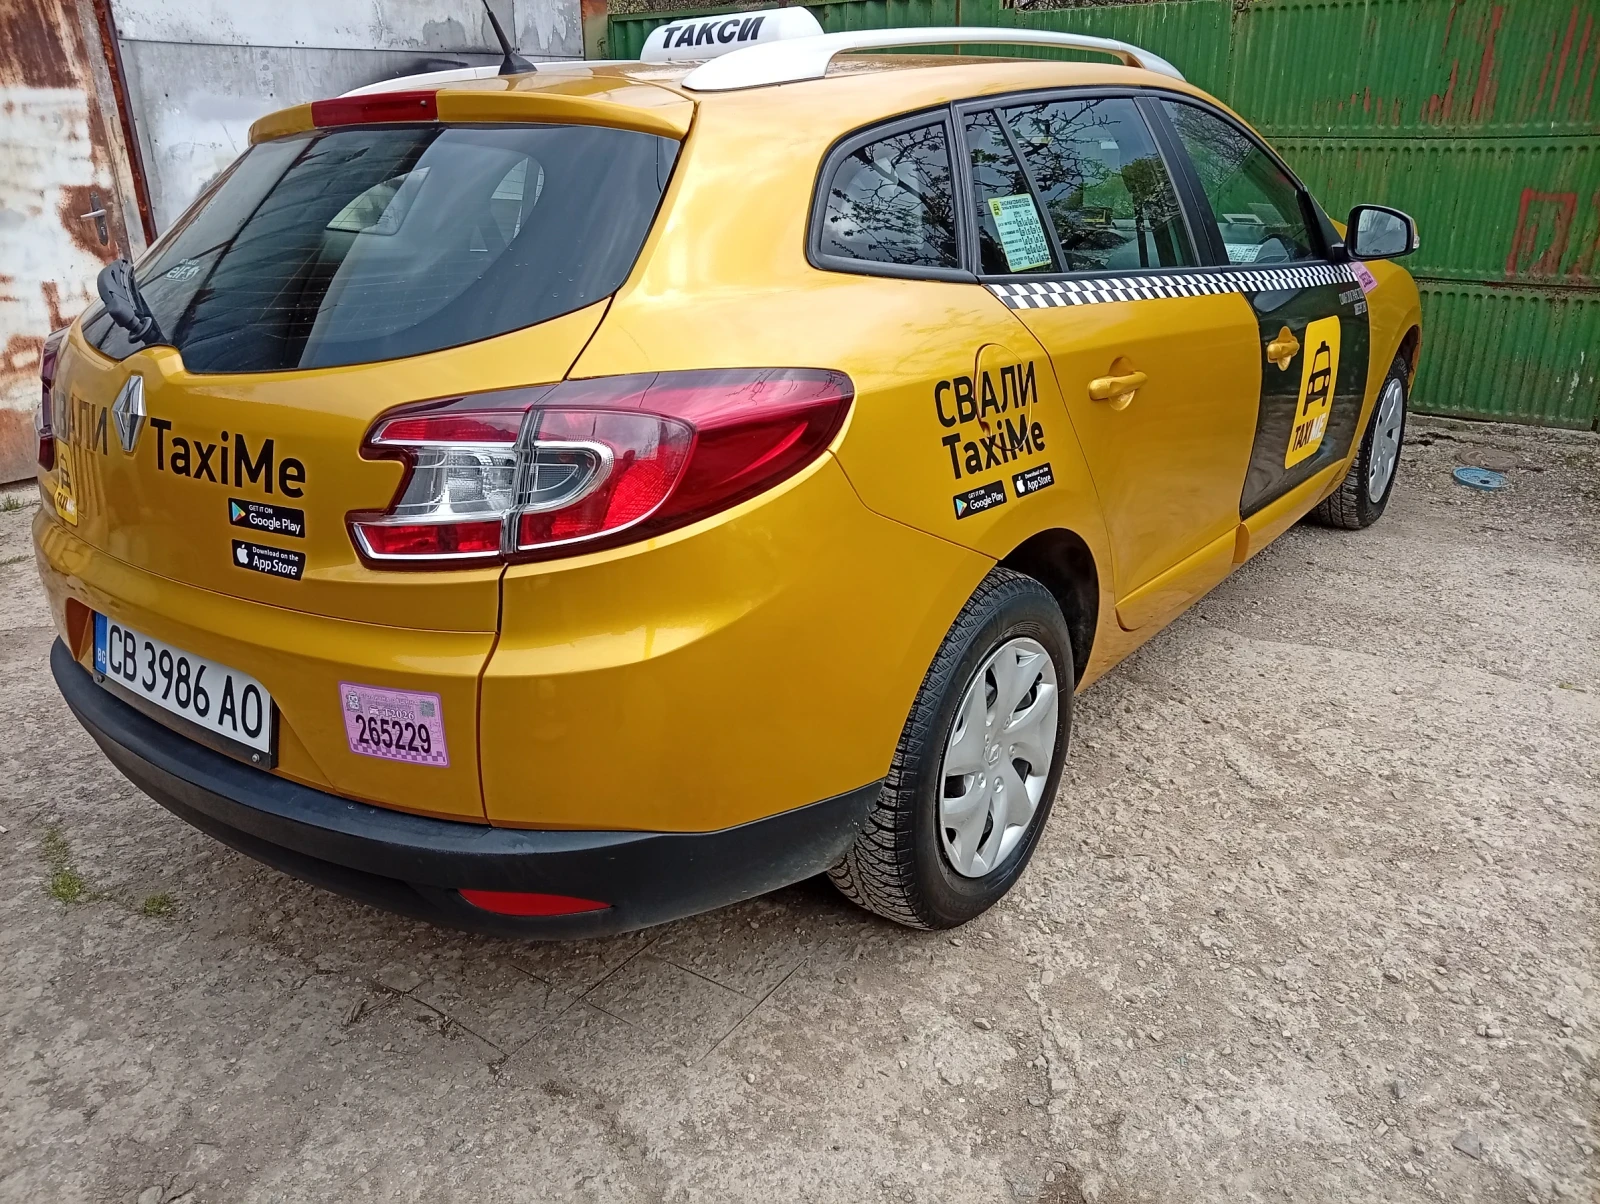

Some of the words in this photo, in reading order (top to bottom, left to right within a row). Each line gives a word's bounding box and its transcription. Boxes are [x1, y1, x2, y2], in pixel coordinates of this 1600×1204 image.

[663, 16, 766, 48] ТАКСИ
[934, 361, 1038, 428] СВАЛИ
[150, 417, 306, 498] TaxiMe
[942, 414, 1046, 480] TaxiMe
[1027, 480, 1039, 491] App
[1037, 475, 1052, 487] Store
[248, 504, 259, 512] GET
[970, 495, 993, 510] Google
[991, 492, 1004, 503] Play
[249, 513, 281, 530] Google
[281, 518, 301, 535] Play
[252, 546, 280, 558] Download
[289, 554, 299, 562] the
[252, 555, 272, 572] App
[272, 559, 298, 576] Store
[97, 648, 106, 665] BG
[109, 624, 137, 682] CB
[142, 641, 211, 717] 3986
[355, 714, 431, 754] 265229
